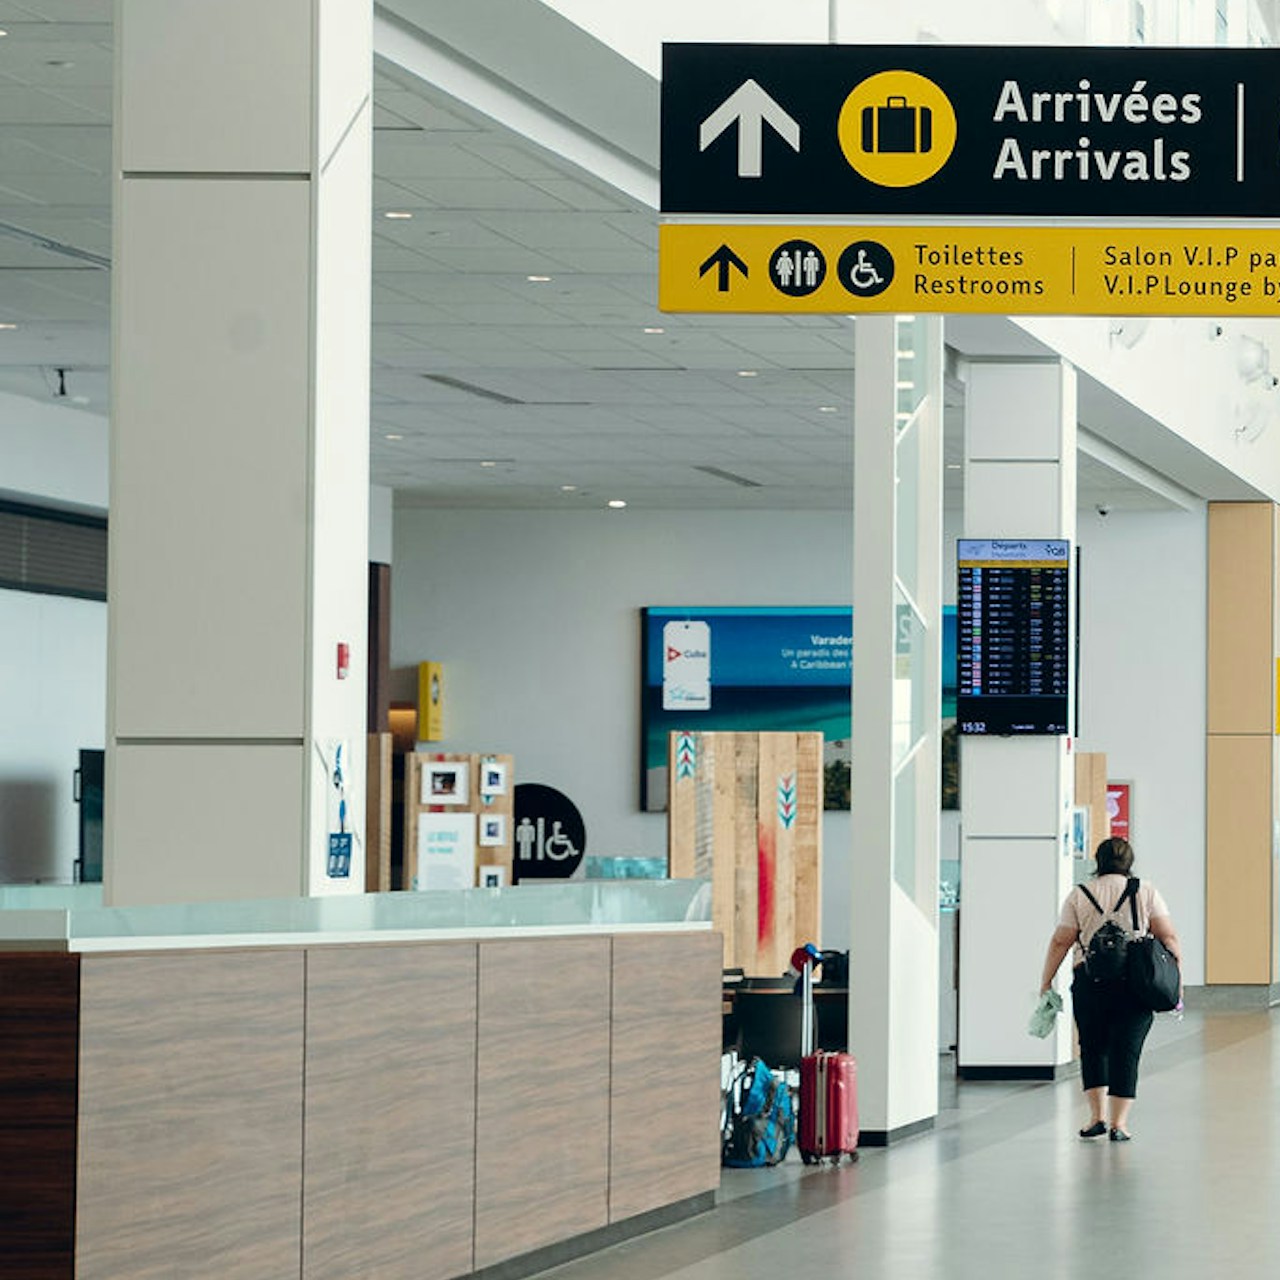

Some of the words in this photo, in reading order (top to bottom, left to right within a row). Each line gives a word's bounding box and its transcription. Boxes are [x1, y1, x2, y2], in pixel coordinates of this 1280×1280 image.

[992, 79, 1203, 124] Arrivées
[992, 137, 1191, 182] Arrivals
[913, 244, 1025, 268] Toilettes
[1103, 245, 1172, 268] Salon
[1184, 246, 1240, 268] V.I.P
[913, 274, 1045, 297] Restrooms
